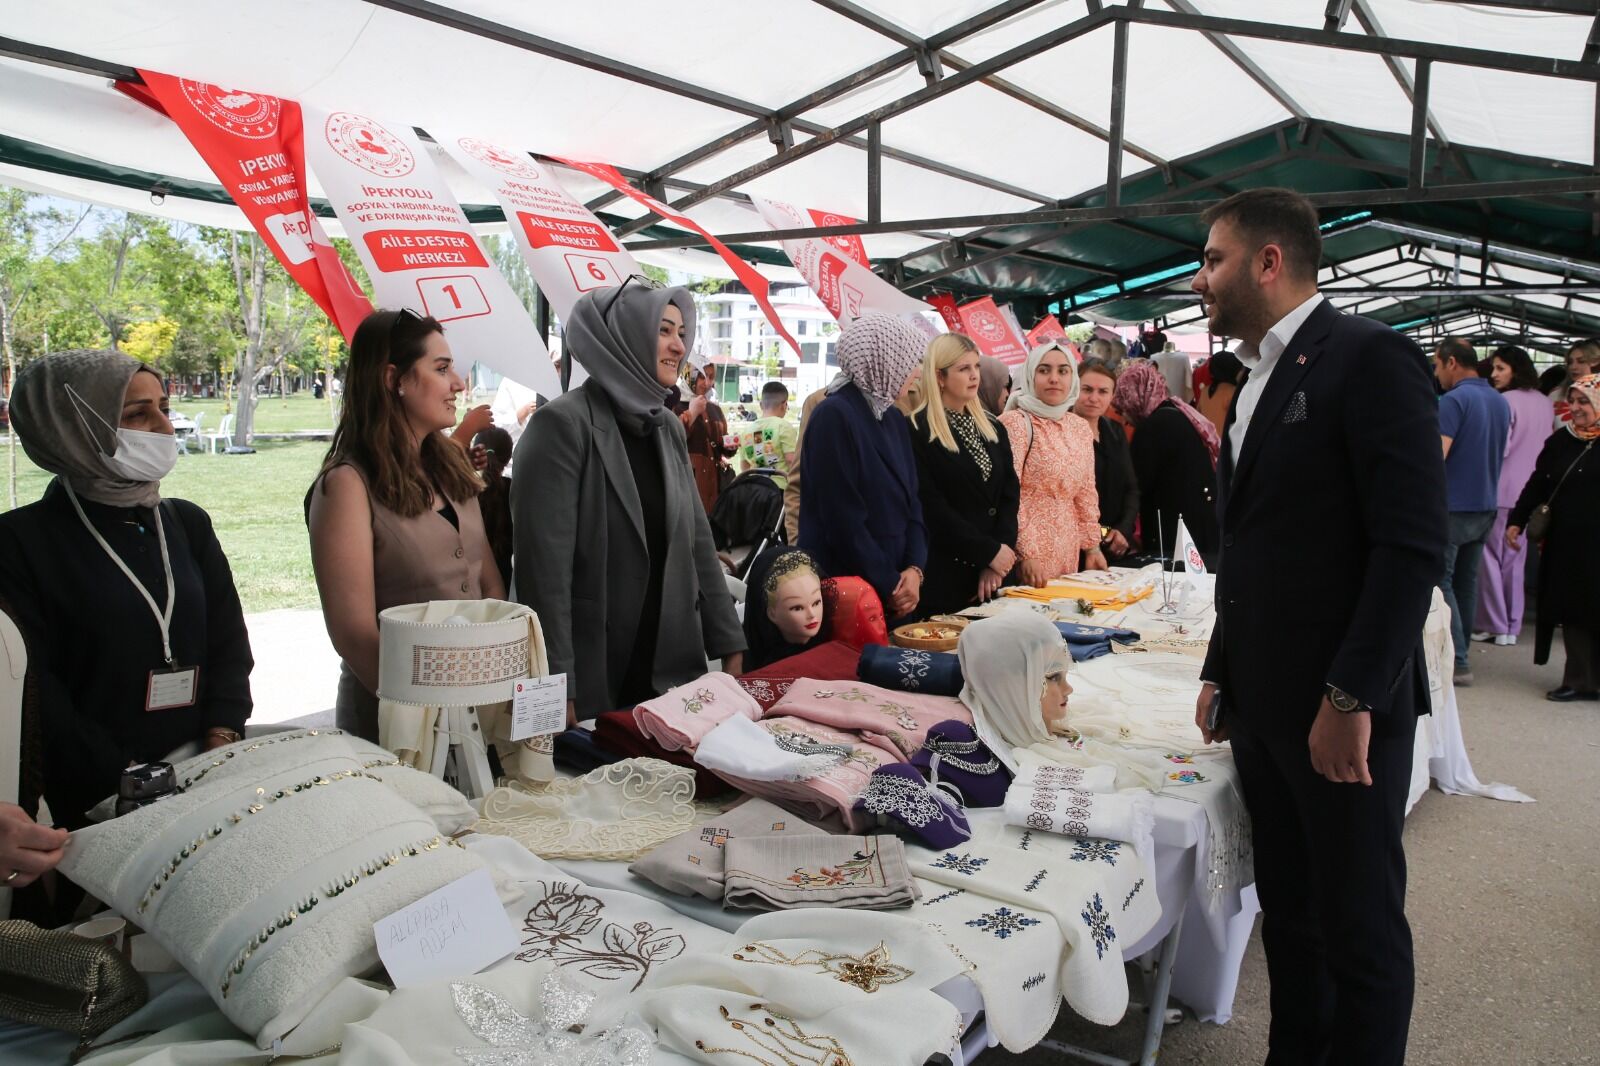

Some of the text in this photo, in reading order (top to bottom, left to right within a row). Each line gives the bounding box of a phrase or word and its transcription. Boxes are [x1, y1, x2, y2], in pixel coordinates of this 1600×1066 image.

[239, 152, 288, 177] İPEKYO
[361, 184, 433, 200] İPEKYOLU
[347, 202, 458, 215] SOSYAL YARDIMLAŞMA
[357, 212, 461, 224] VE DAYANIŞMA VAKFI
[530, 217, 600, 236] AİLE DESTEK
[381, 234, 469, 248] AİLE DESTEK
[549, 233, 600, 248] MERKEZİ
[402, 250, 466, 265] MERKEZİ
[587, 262, 606, 281] 6
[442, 284, 462, 309] 1
